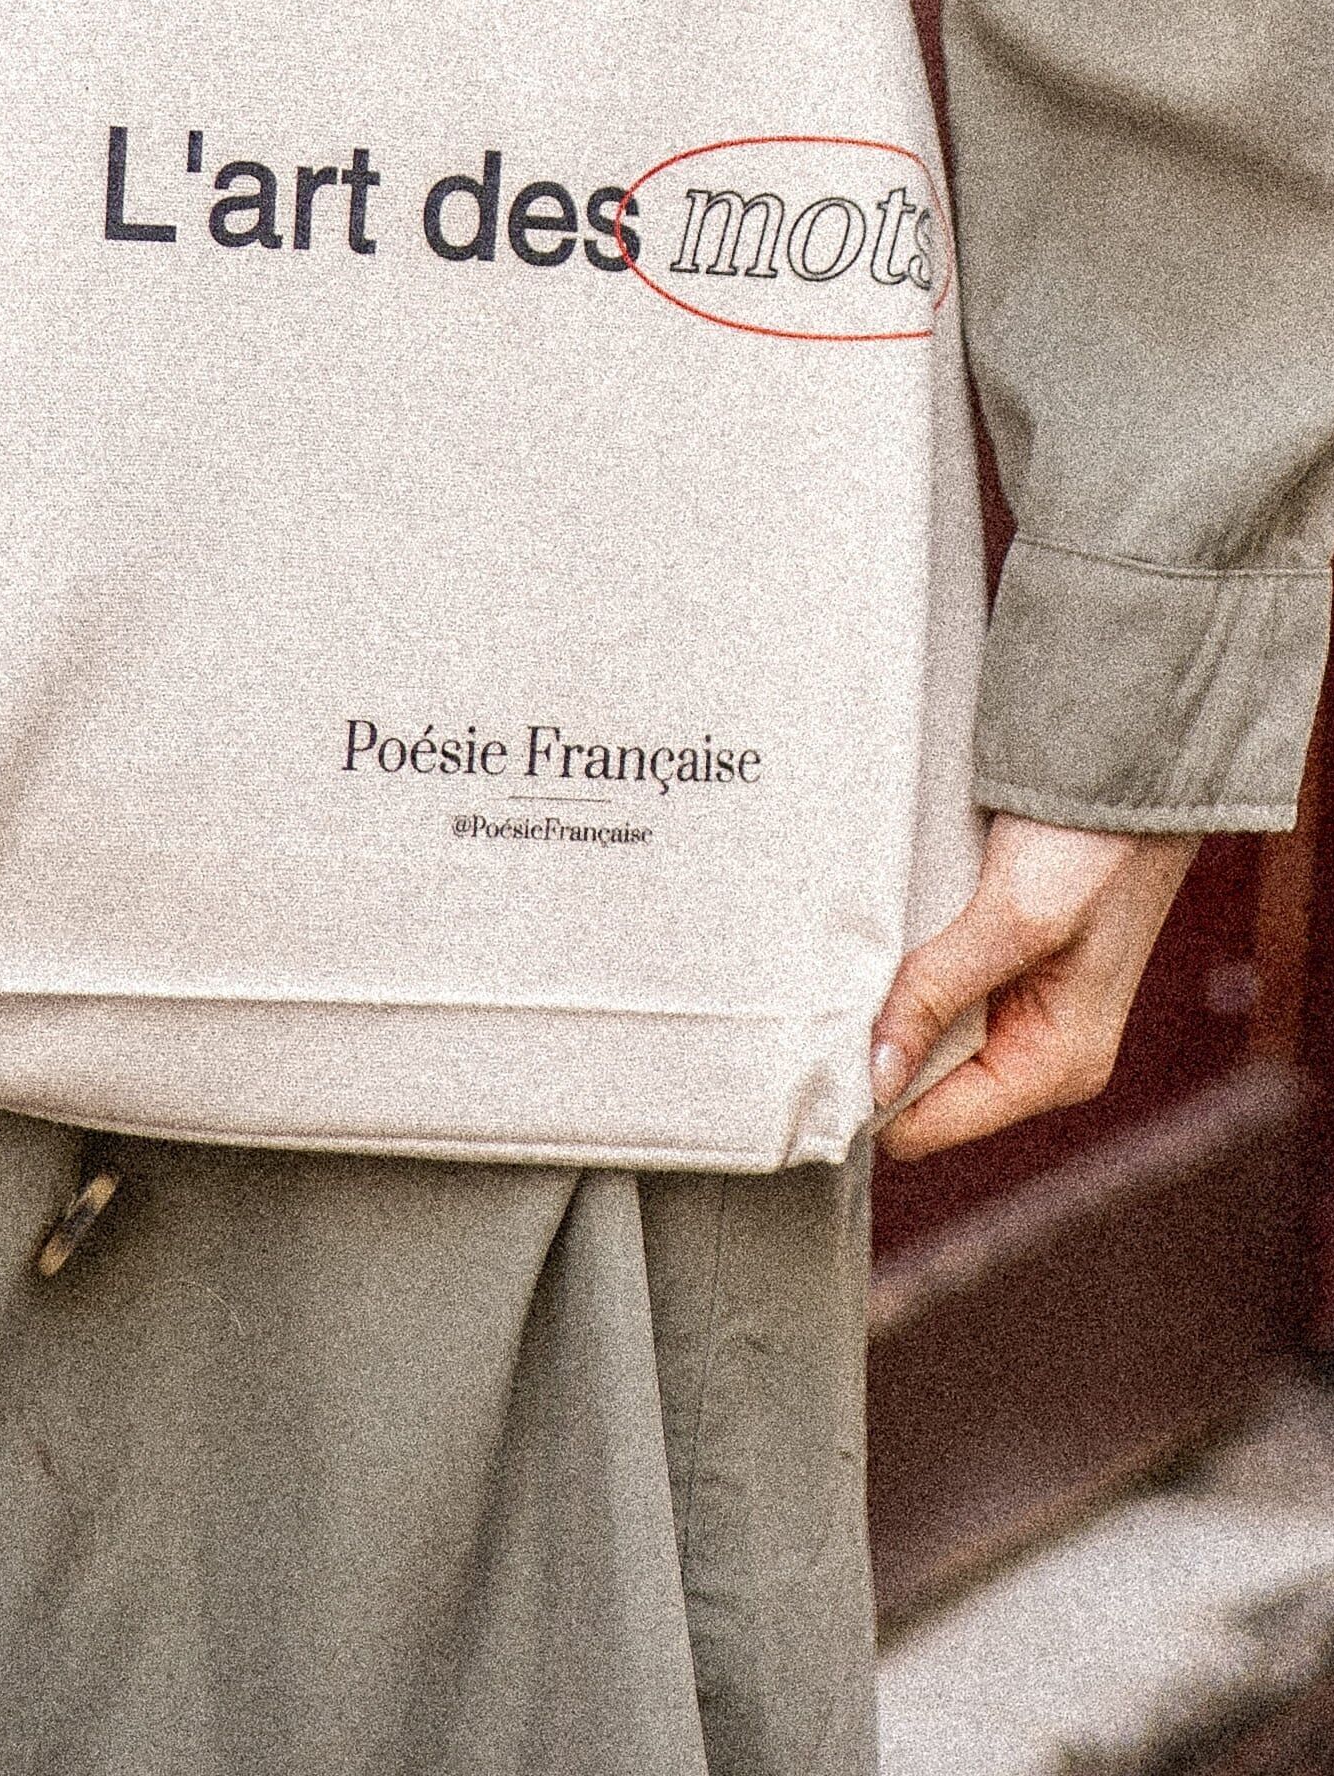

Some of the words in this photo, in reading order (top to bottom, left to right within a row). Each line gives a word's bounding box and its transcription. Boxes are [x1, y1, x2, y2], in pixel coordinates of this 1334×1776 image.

[103, 124, 379, 256] L'art
[422, 150, 643, 274] des
[341, 718, 509, 776] Poésie
[524, 725, 763, 795] Française
[451, 813, 654, 848] @PoésieFrançaise
